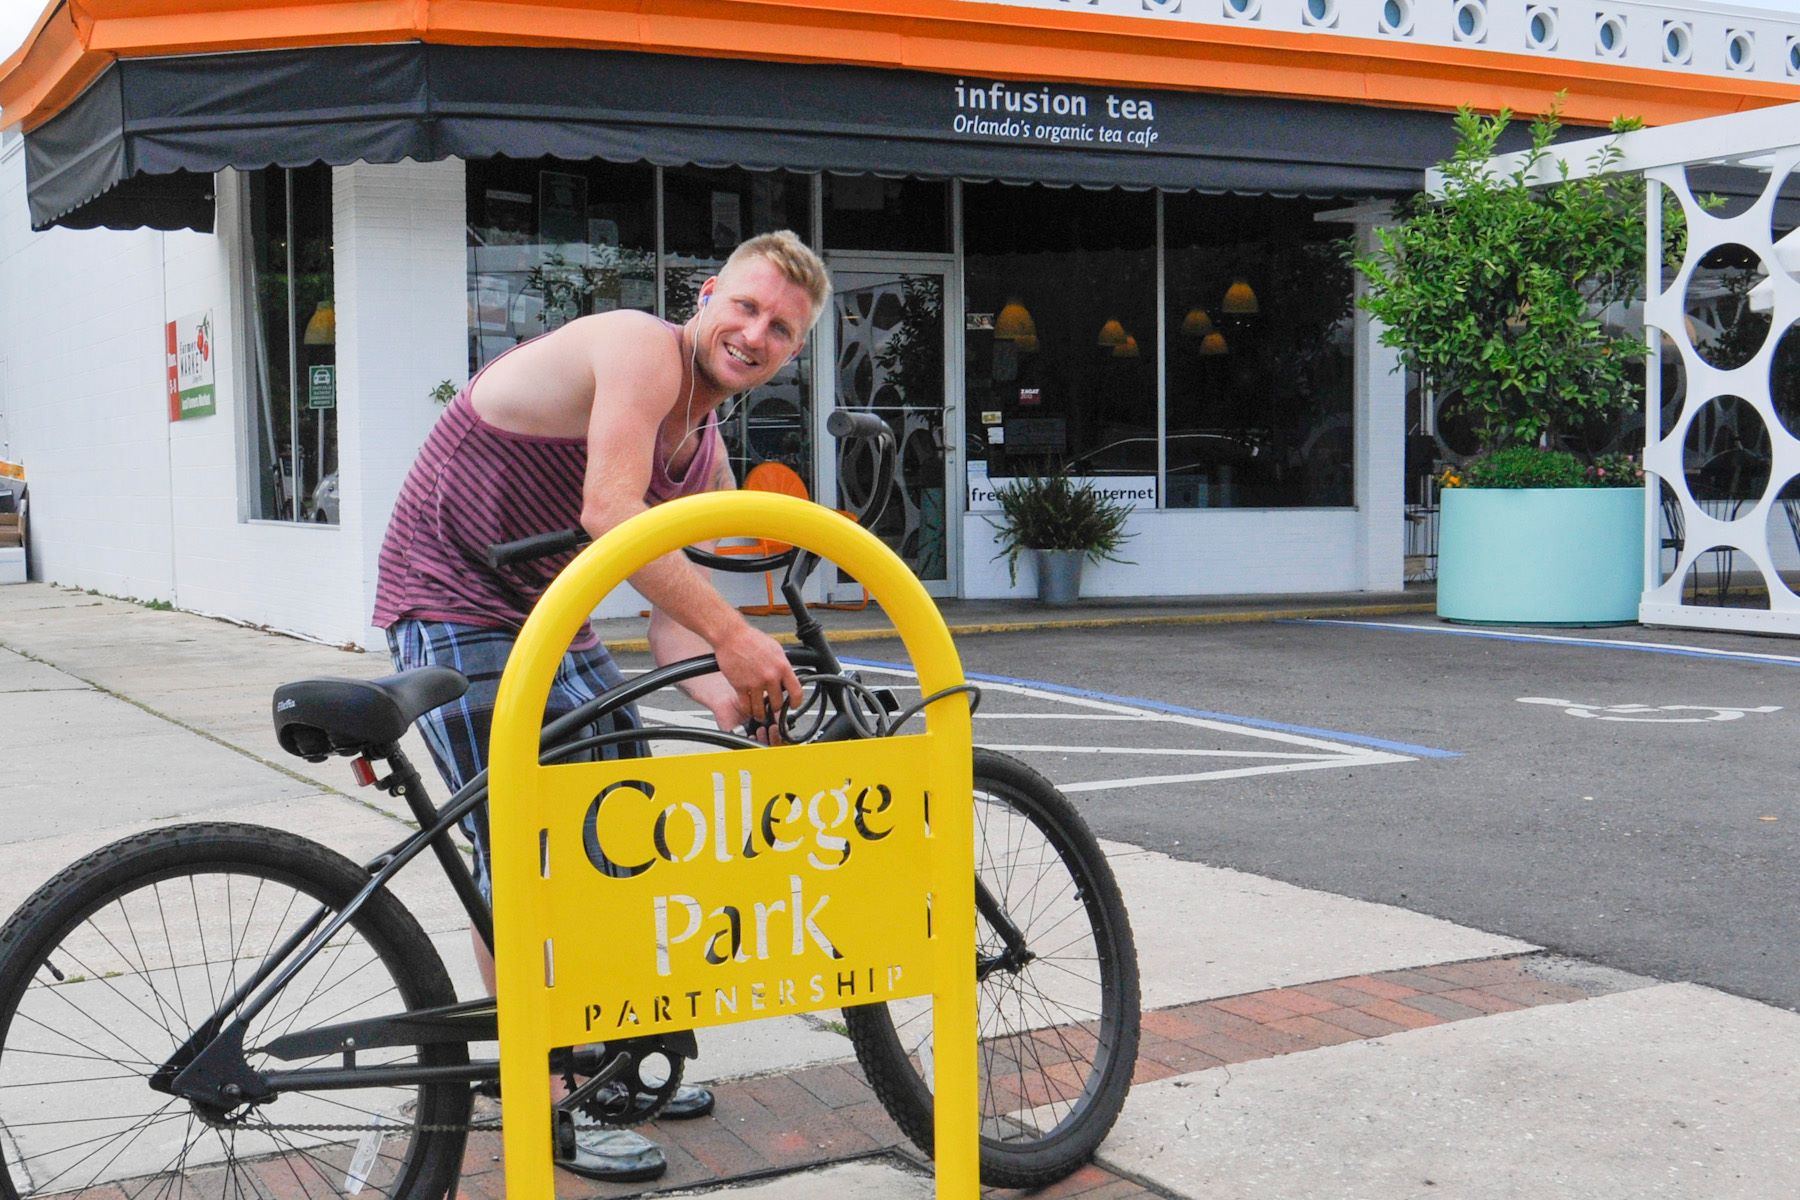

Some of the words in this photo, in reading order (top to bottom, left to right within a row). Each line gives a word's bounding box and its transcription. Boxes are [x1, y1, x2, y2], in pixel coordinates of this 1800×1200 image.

[953, 114, 1031, 138] Orlando's
[1035, 123, 1094, 143] organic
[1099, 126, 1123, 144] tea
[1127, 126, 1159, 148] cafe
[955, 79, 1088, 116] infusion
[1106, 94, 1155, 121] tea
[582, 769, 896, 880] College
[652, 874, 845, 977] Park
[584, 964, 905, 1033] PARTNERSHIP
